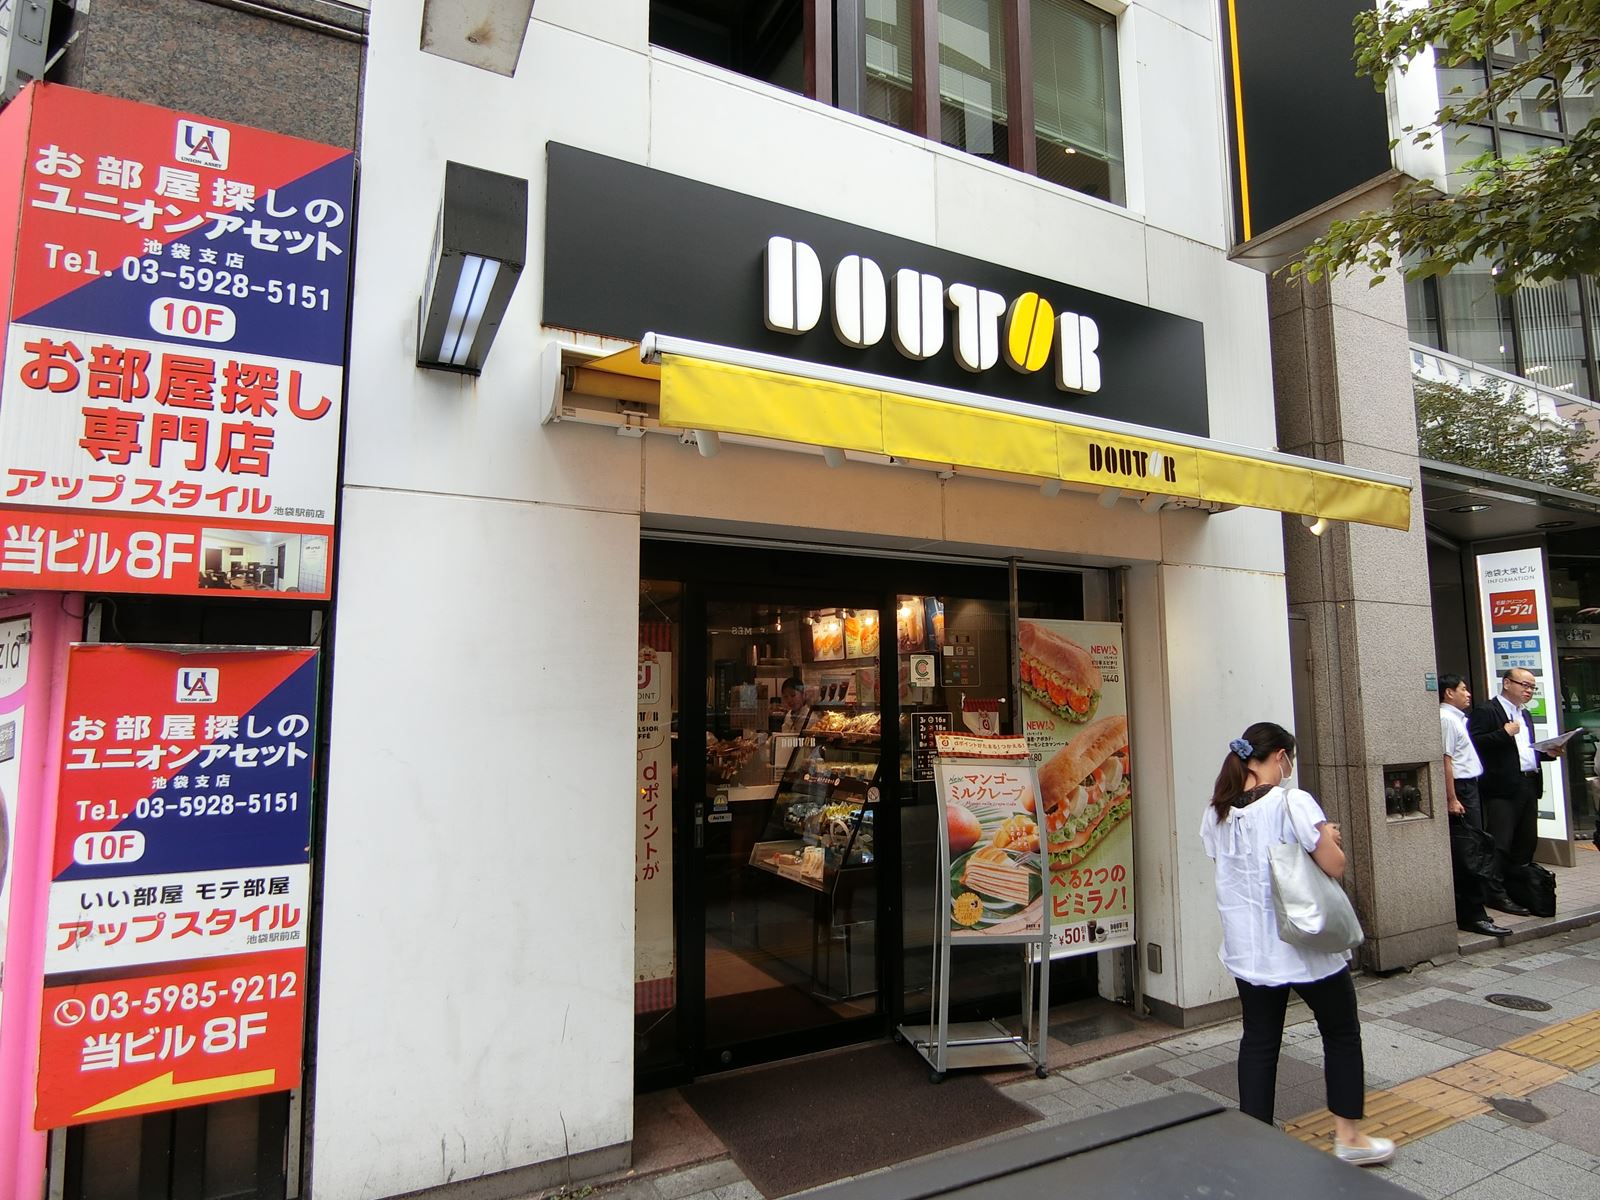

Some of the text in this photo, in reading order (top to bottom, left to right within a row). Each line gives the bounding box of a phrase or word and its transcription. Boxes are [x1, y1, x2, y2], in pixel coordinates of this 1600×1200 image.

[181, 156, 202, 164] UNION
[36, 144, 344, 228] お部屋探しの
[32, 183, 343, 261] ユニオンアセット
[143, 238, 244, 268] 池袋支店
[45, 244, 329, 310] Tel. 03-5928-5151
[164, 303, 224, 335] 10F
[765, 236, 1101, 394] DOUTOR
[20, 338, 332, 421] お部屋探し
[79, 406, 274, 477] 専門店
[1089, 443, 1177, 483] DOUTOR
[6, 468, 272, 514] アップスタイル
[274, 506, 325, 519] 池袋駅前店
[1, 524, 195, 580] 当ビル8F
[1487, 575, 1535, 584] INFORMATION
[1494, 604, 1533, 616] リーブ21
[69, 714, 310, 741] お部屋探しの
[66, 742, 308, 771] ユニオンアセット
[152, 774, 231, 789] 池袋支店
[951, 785, 1025, 801] ミルクレープ
[965, 772, 1018, 786] マンゴー
[76, 792, 298, 821] Tel. 03-5928-5151
[85, 834, 135, 860] 10F
[81, 876, 290, 910] いい部屋 モテ部屋
[58, 903, 300, 951] アップスタイル
[247, 931, 300, 945] 池袋駅前店
[91, 971, 297, 1021] 03-5985-9212
[80, 1012, 268, 1071] 当ビル8F
